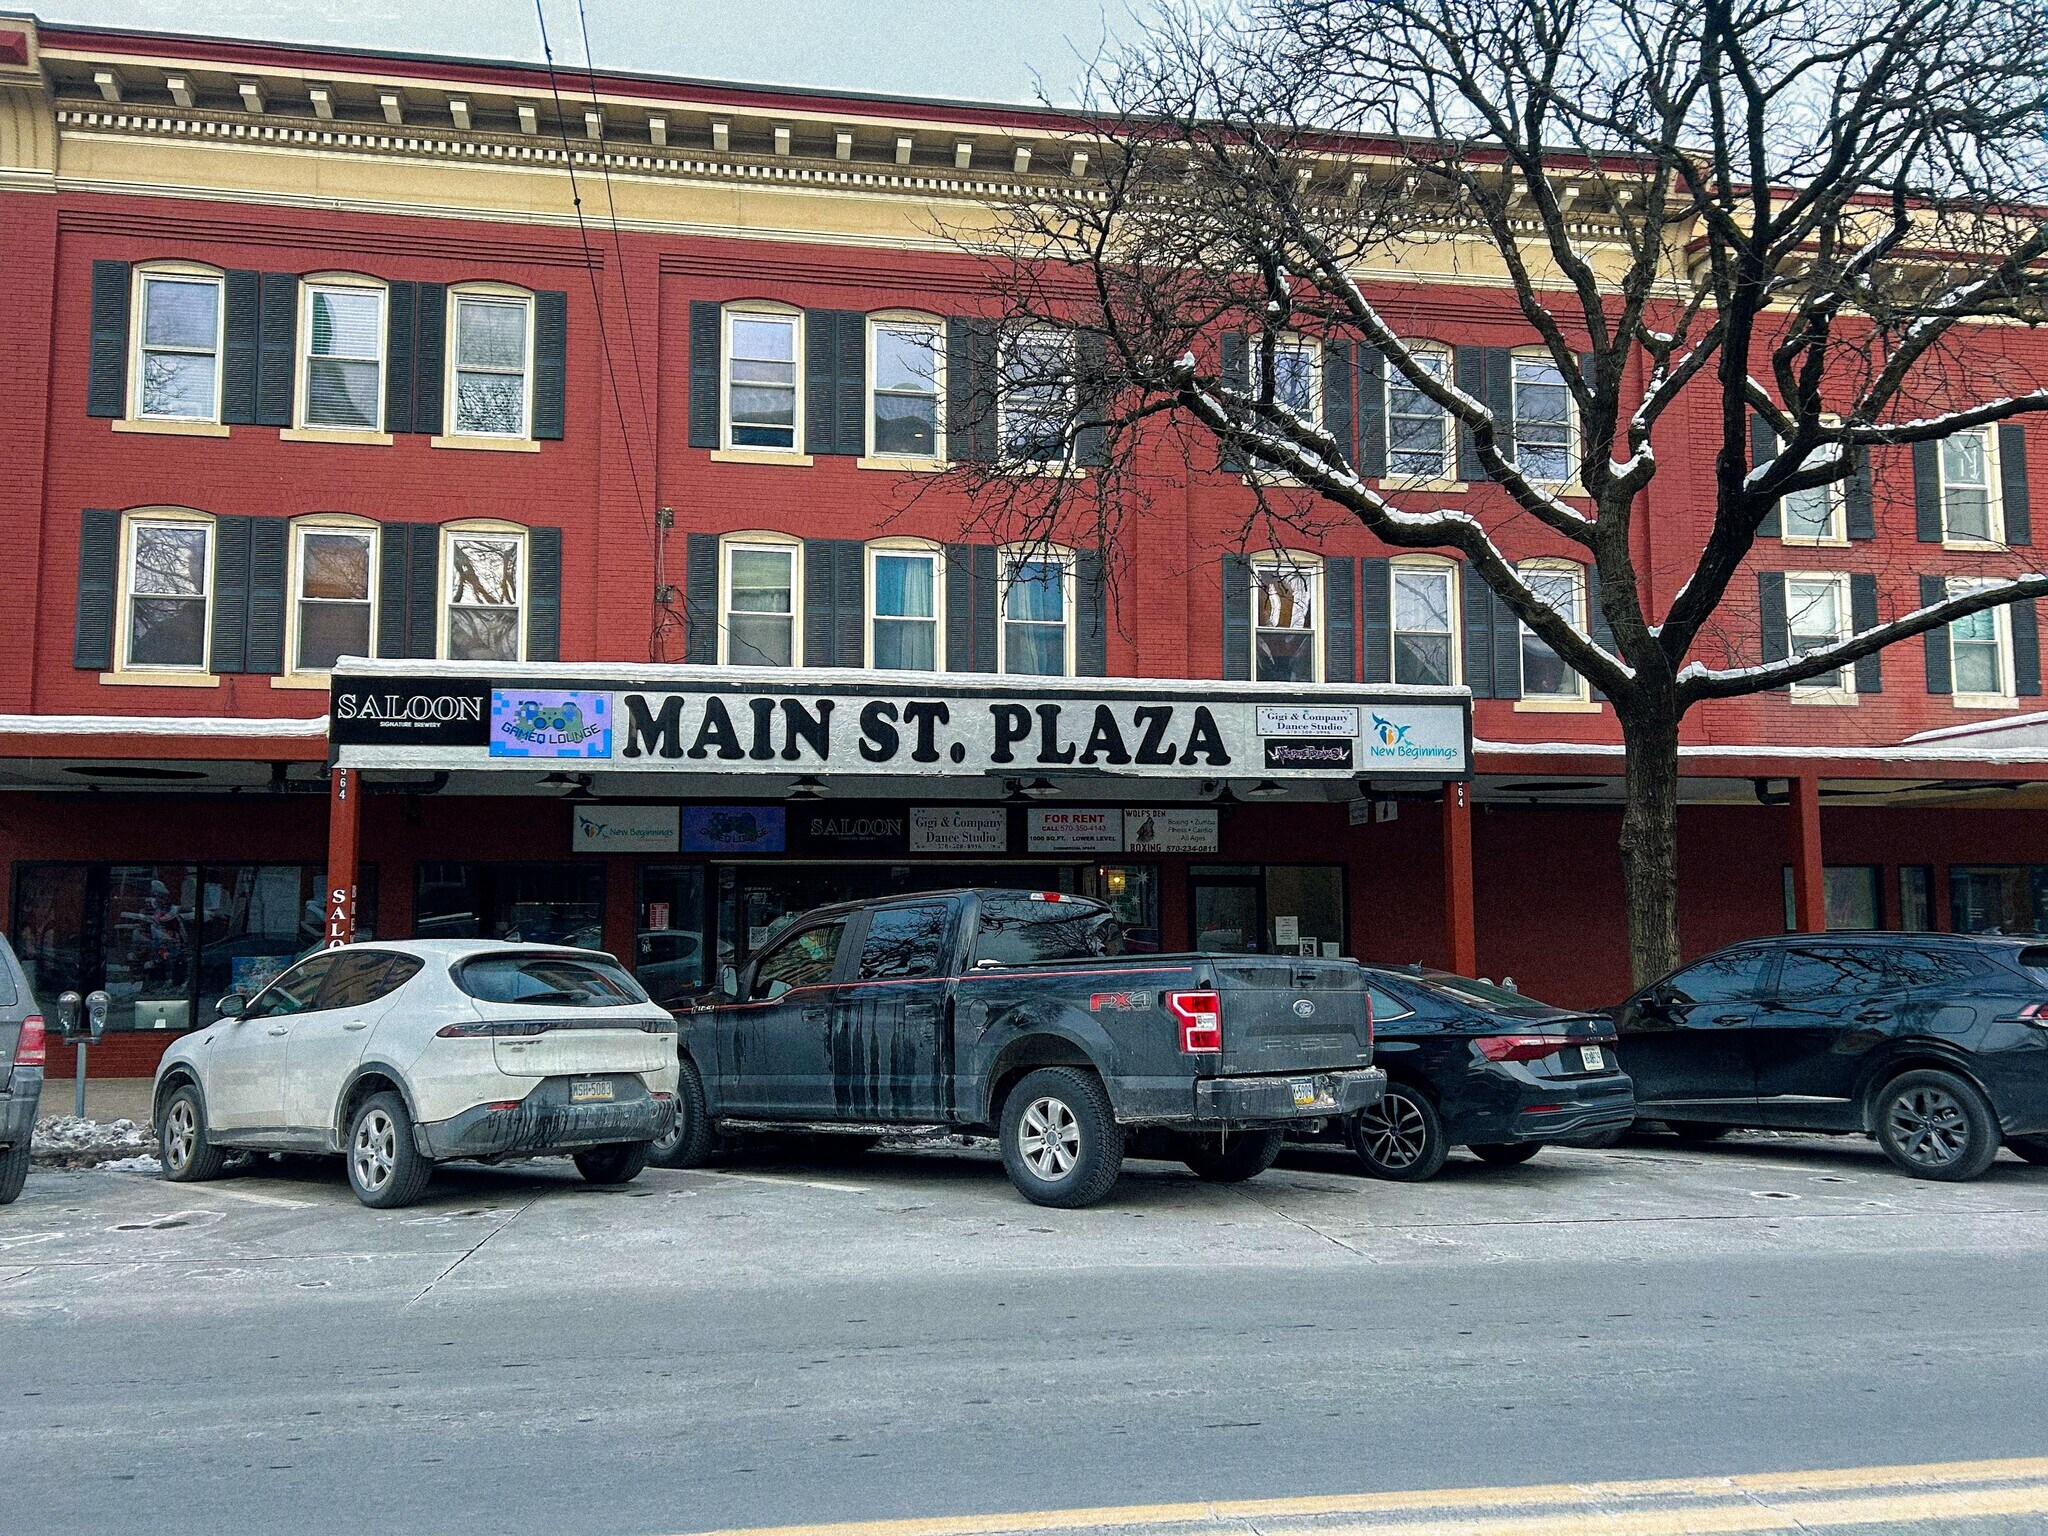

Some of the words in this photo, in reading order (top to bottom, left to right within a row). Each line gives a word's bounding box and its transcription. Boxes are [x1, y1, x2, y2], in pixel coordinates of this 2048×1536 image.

[338, 694, 483, 720] SALOON
[1267, 713, 1287, 721] Gigi
[1302, 713, 1349, 723] Company
[622, 694, 835, 761] MAIN
[858, 700, 966, 764] ST.
[989, 703, 1231, 765] PLAZA
[1277, 722, 1308, 730] Dance
[1311, 722, 1343, 731] Studio
[549, 723, 601, 744] LOUNGE
[1370, 746, 1395, 757] New
[1398, 746, 1458, 760] Beginnings
[915, 816, 937, 831] Gigi
[940, 817, 950, 827] &
[953, 816, 1001, 831] Company
[1044, 814, 1069, 823] FOR
[1072, 814, 1105, 823] RENT
[1168, 818, 1189, 827] Boxing
[609, 828, 628, 836] New
[629, 828, 674, 838] Beginnings
[810, 818, 903, 836] SALOON
[926, 831, 960, 843] Dance
[962, 831, 996, 843] Studio
[1130, 843, 1162, 852] BOXING
[1090, 989, 1152, 1012] FX4
